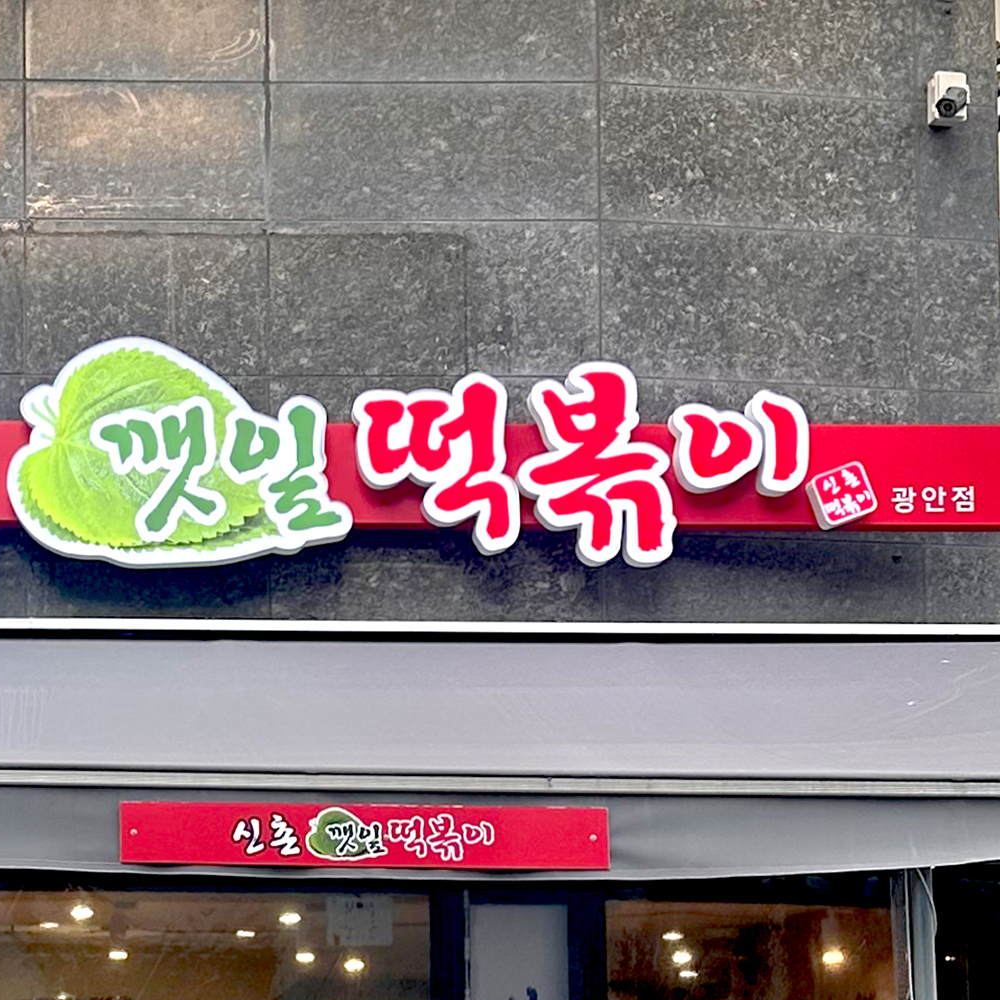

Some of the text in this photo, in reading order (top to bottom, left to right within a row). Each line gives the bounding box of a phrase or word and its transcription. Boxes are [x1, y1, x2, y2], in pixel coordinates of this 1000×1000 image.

[92, 396, 352, 543] 깻잎
[354, 363, 809, 563] 떡볶이
[890, 485, 976, 514] 광안점
[232, 813, 495, 861] 신촌 깻잎 떡볶이
